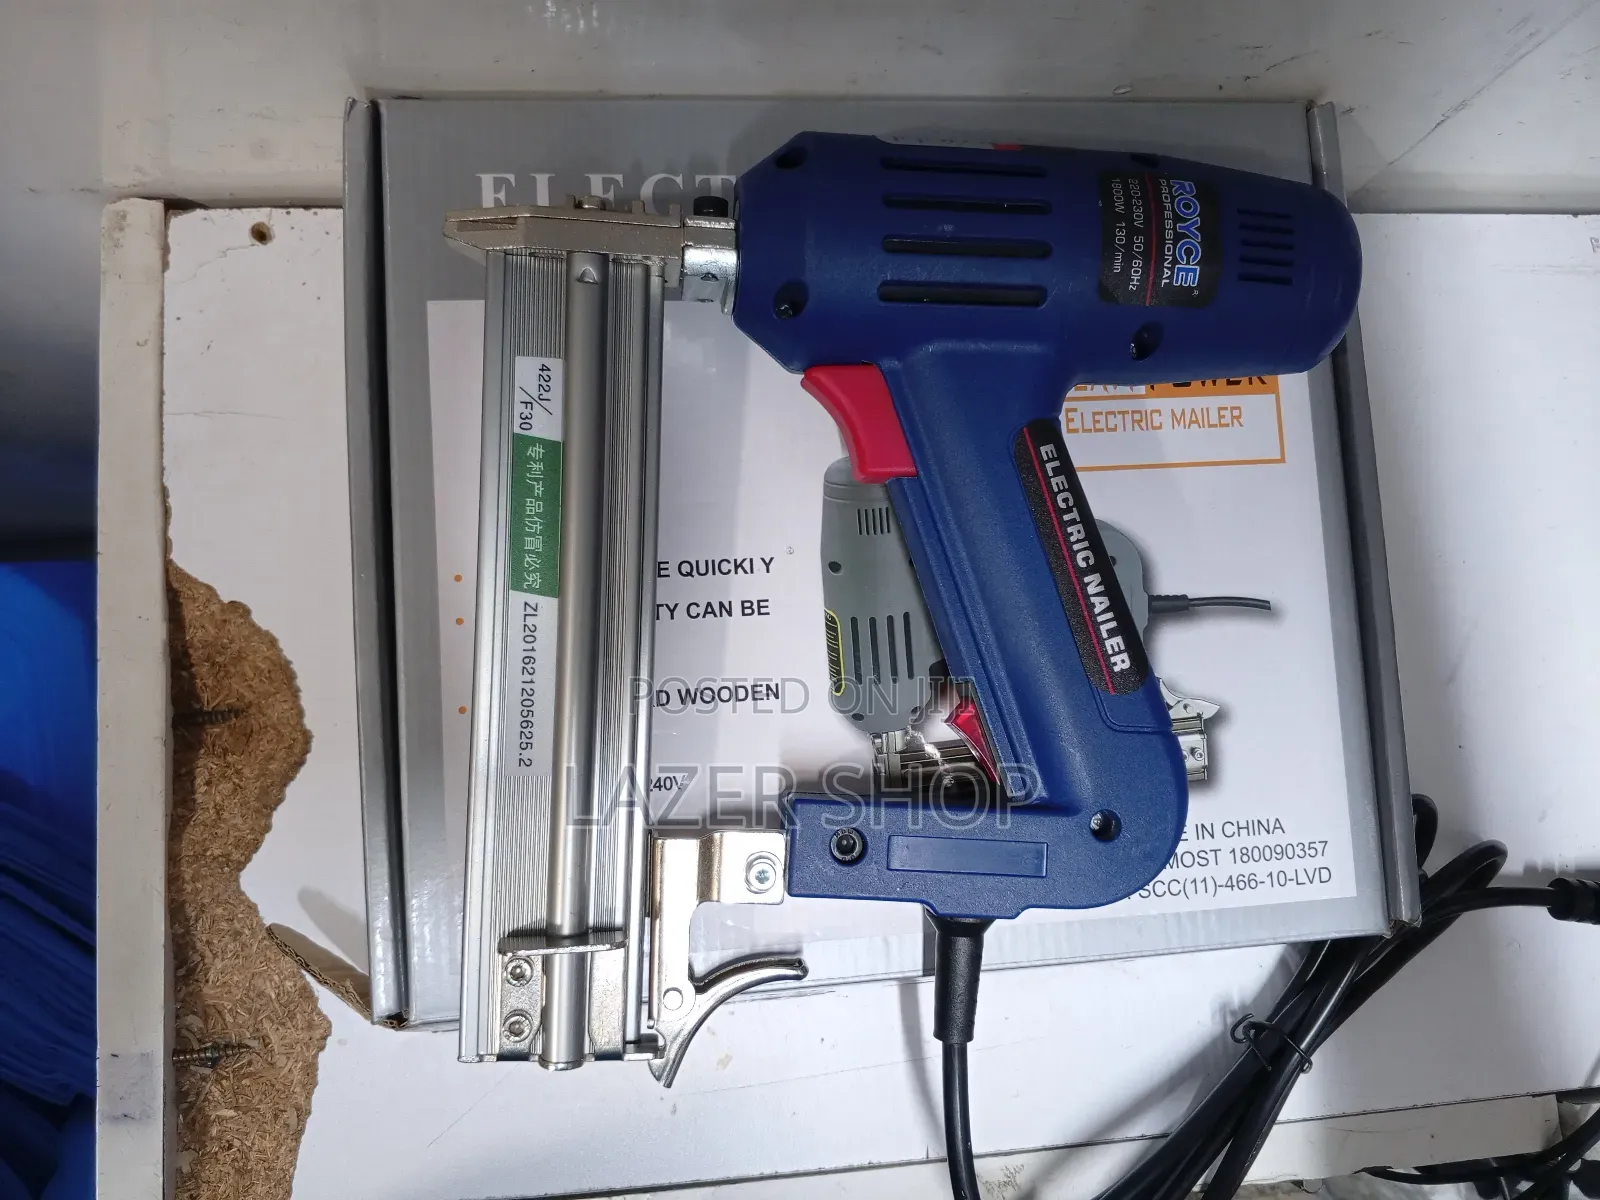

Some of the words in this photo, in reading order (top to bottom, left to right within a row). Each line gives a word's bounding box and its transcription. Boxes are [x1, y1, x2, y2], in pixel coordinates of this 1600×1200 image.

[1112, 179, 1125, 214] 1800W
[1113, 222, 1126, 273] 130/min
[1158, 179, 1173, 287] PROFESSIONAL
[1170, 180, 1201, 287] ROYCE
[1129, 236, 1144, 291] 50/60Hz
[1065, 407, 1162, 434] ELECTRIC
[1171, 406, 1243, 430] MAILER
[523, 443, 546, 590] 专利产品仿冒必究
[1040, 444, 1094, 568] ELECTRIC
[1084, 573, 1131, 673] NAILER
[686, 601, 733, 619] CAN
[741, 599, 770, 616] BE
[518, 601, 538, 768] ZL201621205625.2
[677, 683, 780, 706] WOODEN
[1195, 822, 1214, 840] IN
[1221, 818, 1285, 838] CHINA
[1229, 840, 1329, 865] 180090357
